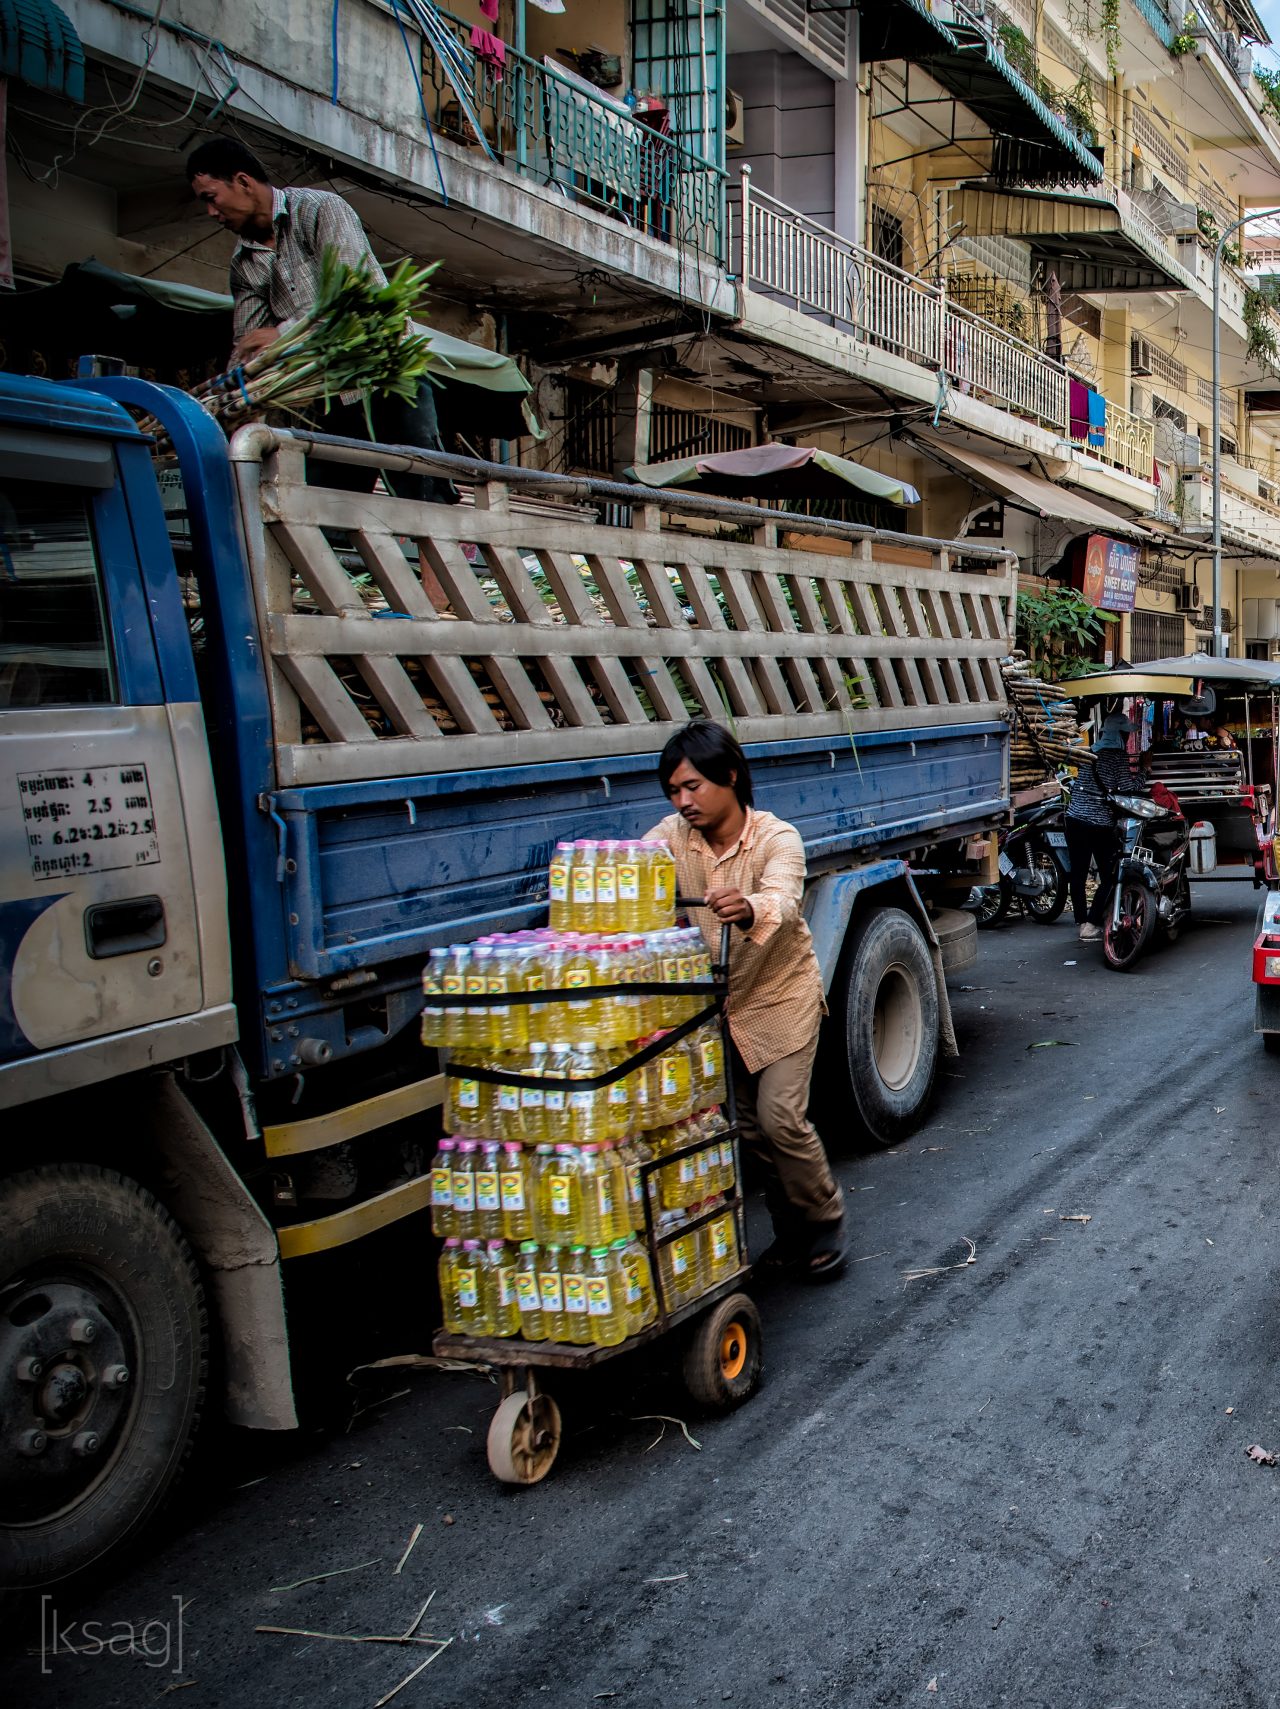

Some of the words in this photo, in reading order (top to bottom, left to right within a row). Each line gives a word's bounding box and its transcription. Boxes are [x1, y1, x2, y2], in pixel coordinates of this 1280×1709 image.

[1104, 574, 1120, 590] SWEET
[1121, 578, 1136, 593] HEART
[83, 773, 93, 787] 4
[88, 797, 113, 815] 2.5
